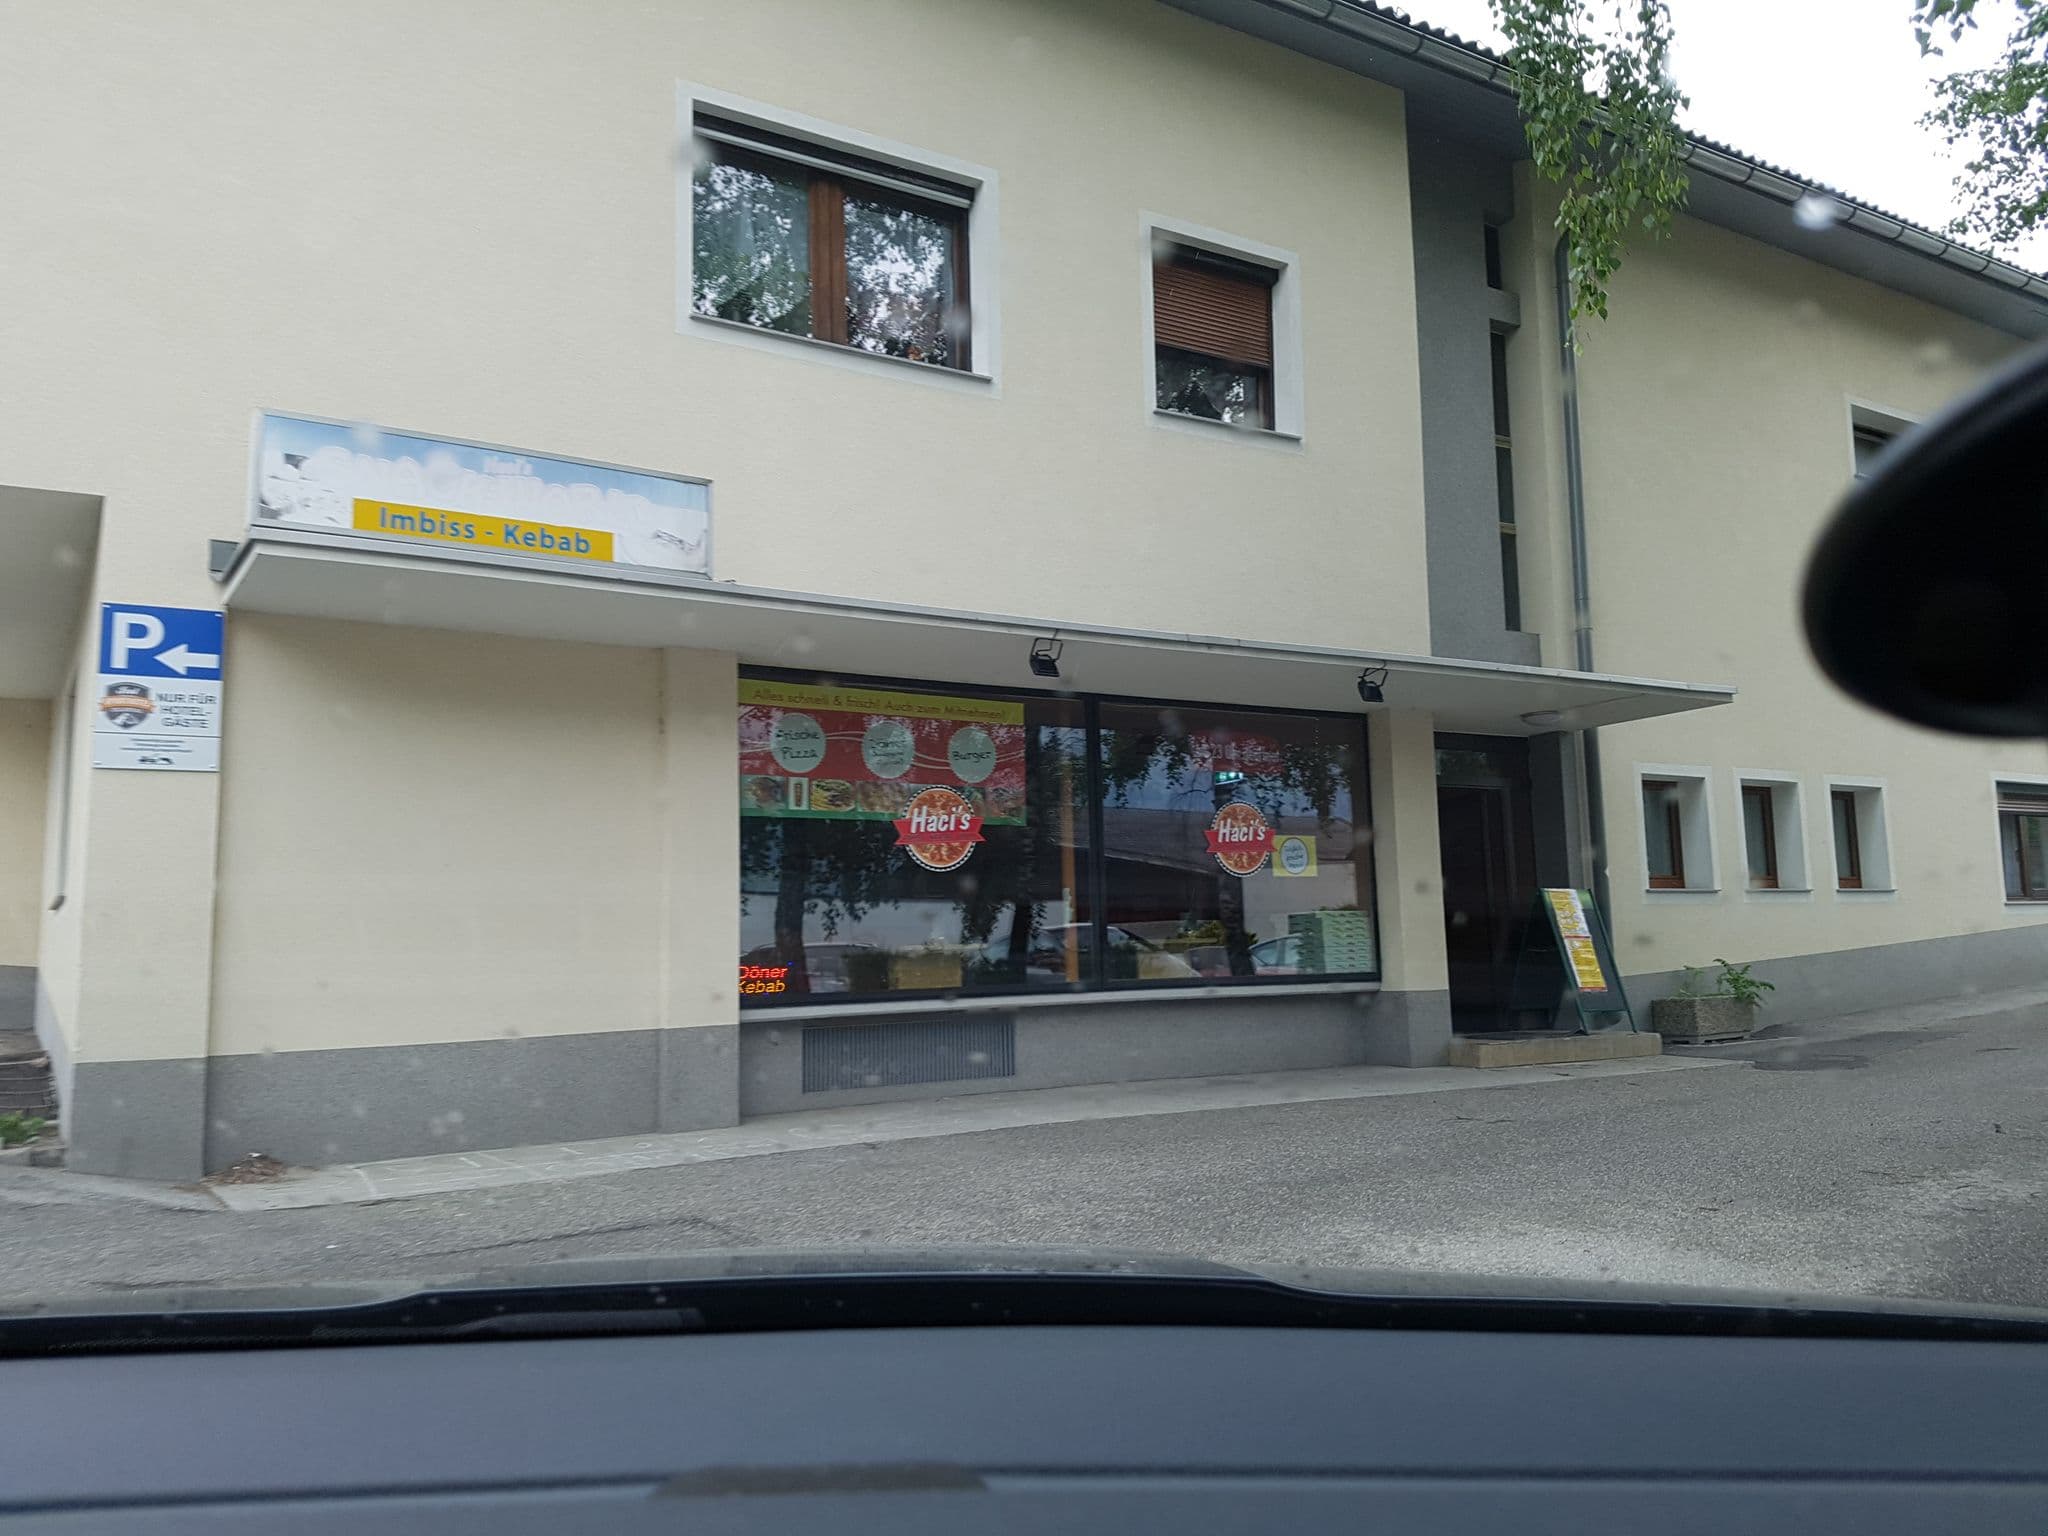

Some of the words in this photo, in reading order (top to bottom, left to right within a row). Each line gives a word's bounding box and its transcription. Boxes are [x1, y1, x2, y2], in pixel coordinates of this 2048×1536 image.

[379, 506, 476, 540] Imbiss
[504, 523, 591, 555] Kebab
[110, 611, 165, 669] P
[156, 693, 187, 703] NUR
[190, 691, 216, 704] FÜR
[752, 689, 784, 703] Alles
[788, 692, 829, 706] schnell
[833, 695, 842, 706] &
[885, 699, 914, 713] Auch
[916, 705, 944, 715] zum
[159, 704, 213, 717] HOTEL-
[161, 713, 210, 729] GÄSTE
[781, 746, 819, 760] Pizza
[952, 750, 992, 764] Burger
[910, 805, 972, 834] Haci's
[1217, 818, 1266, 843] Haci's
[738, 964, 789, 979] Döner
[737, 979, 786, 994] Kebab
